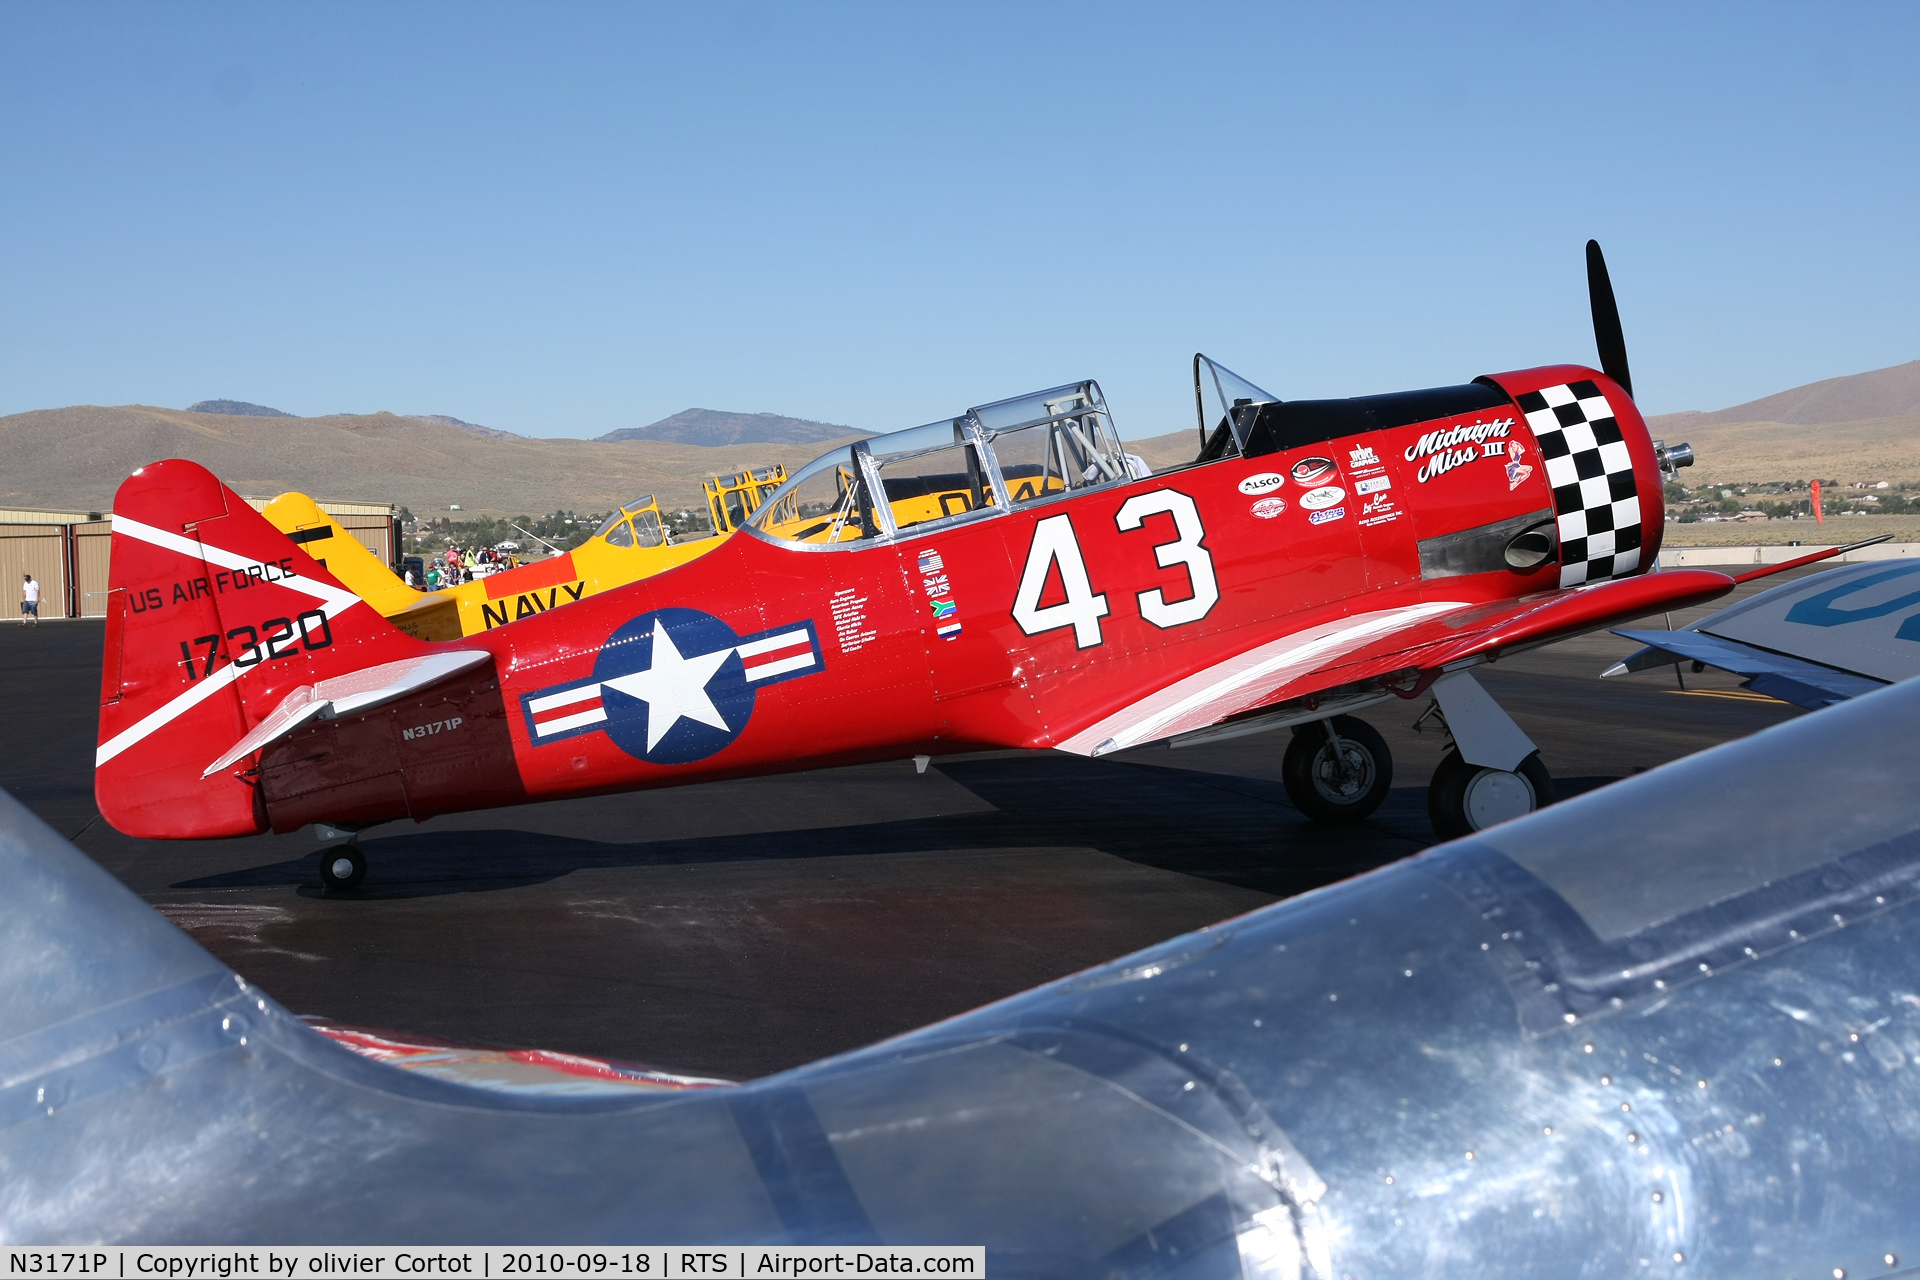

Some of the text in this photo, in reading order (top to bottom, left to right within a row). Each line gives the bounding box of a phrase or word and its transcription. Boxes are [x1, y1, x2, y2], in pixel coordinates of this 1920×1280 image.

[1404, 418, 1516, 462] Midnight
[1244, 477, 1280, 490] ALSCO
[1417, 442, 1506, 484] Miss III
[130, 558, 296, 614] US AIR FORCE
[1010, 487, 1221, 652] 43
[482, 581, 586, 630] NAVY
[402, 717, 463, 740] N3171P
